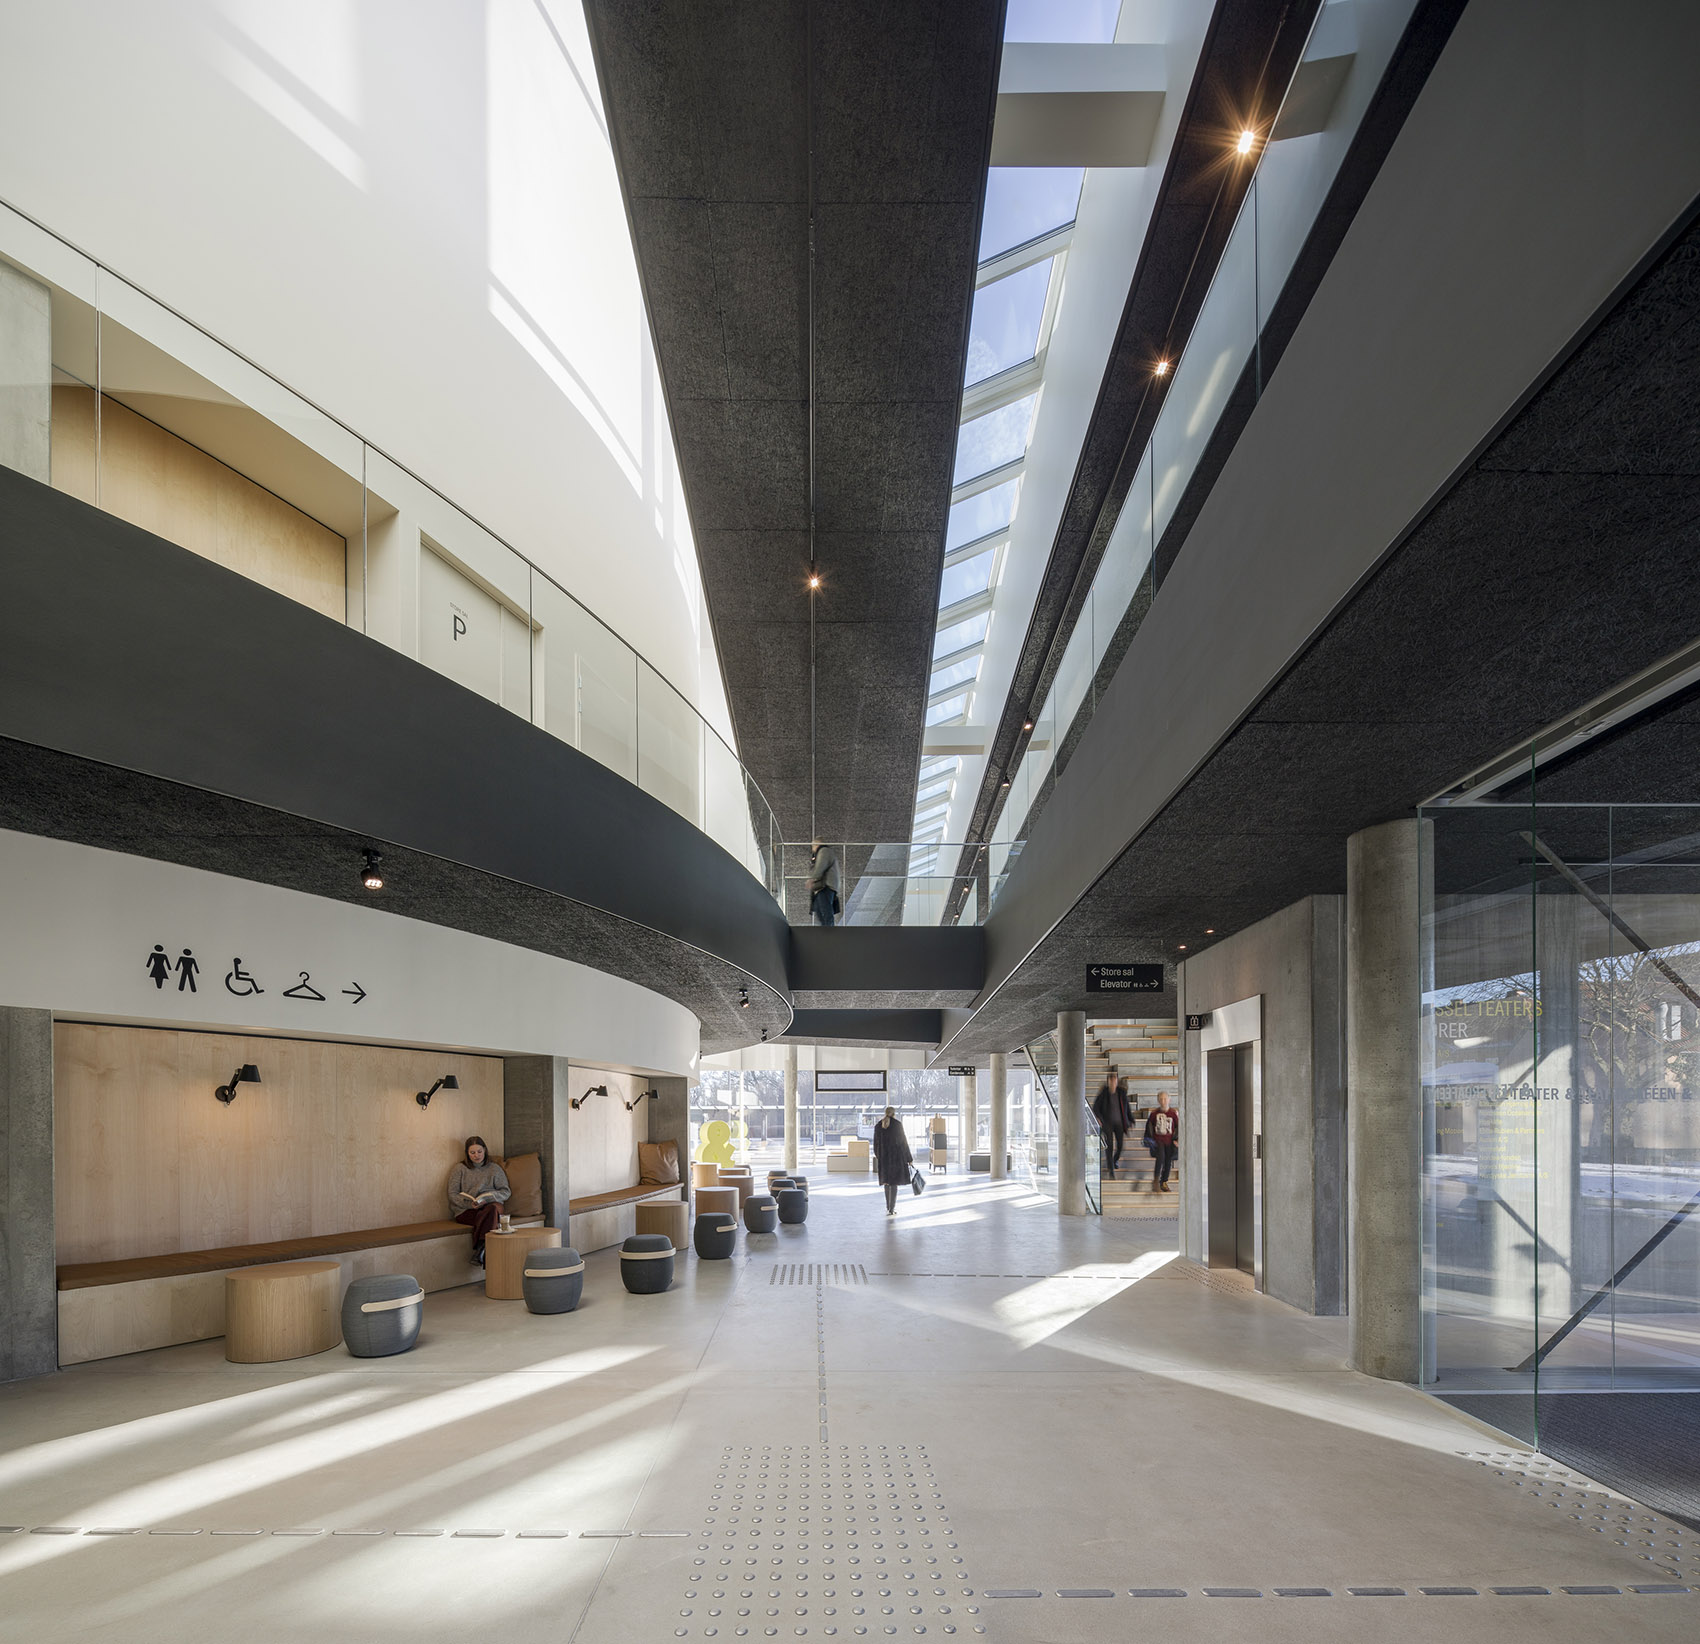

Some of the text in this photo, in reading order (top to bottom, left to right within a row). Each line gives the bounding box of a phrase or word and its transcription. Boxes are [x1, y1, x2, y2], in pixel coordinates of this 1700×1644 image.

[454, 614, 466, 641] P
[1101, 967, 1134, 976] Store sal
[1100, 980, 1132, 988] Elevator
[1477, 1001, 1543, 1017] TEATERS
